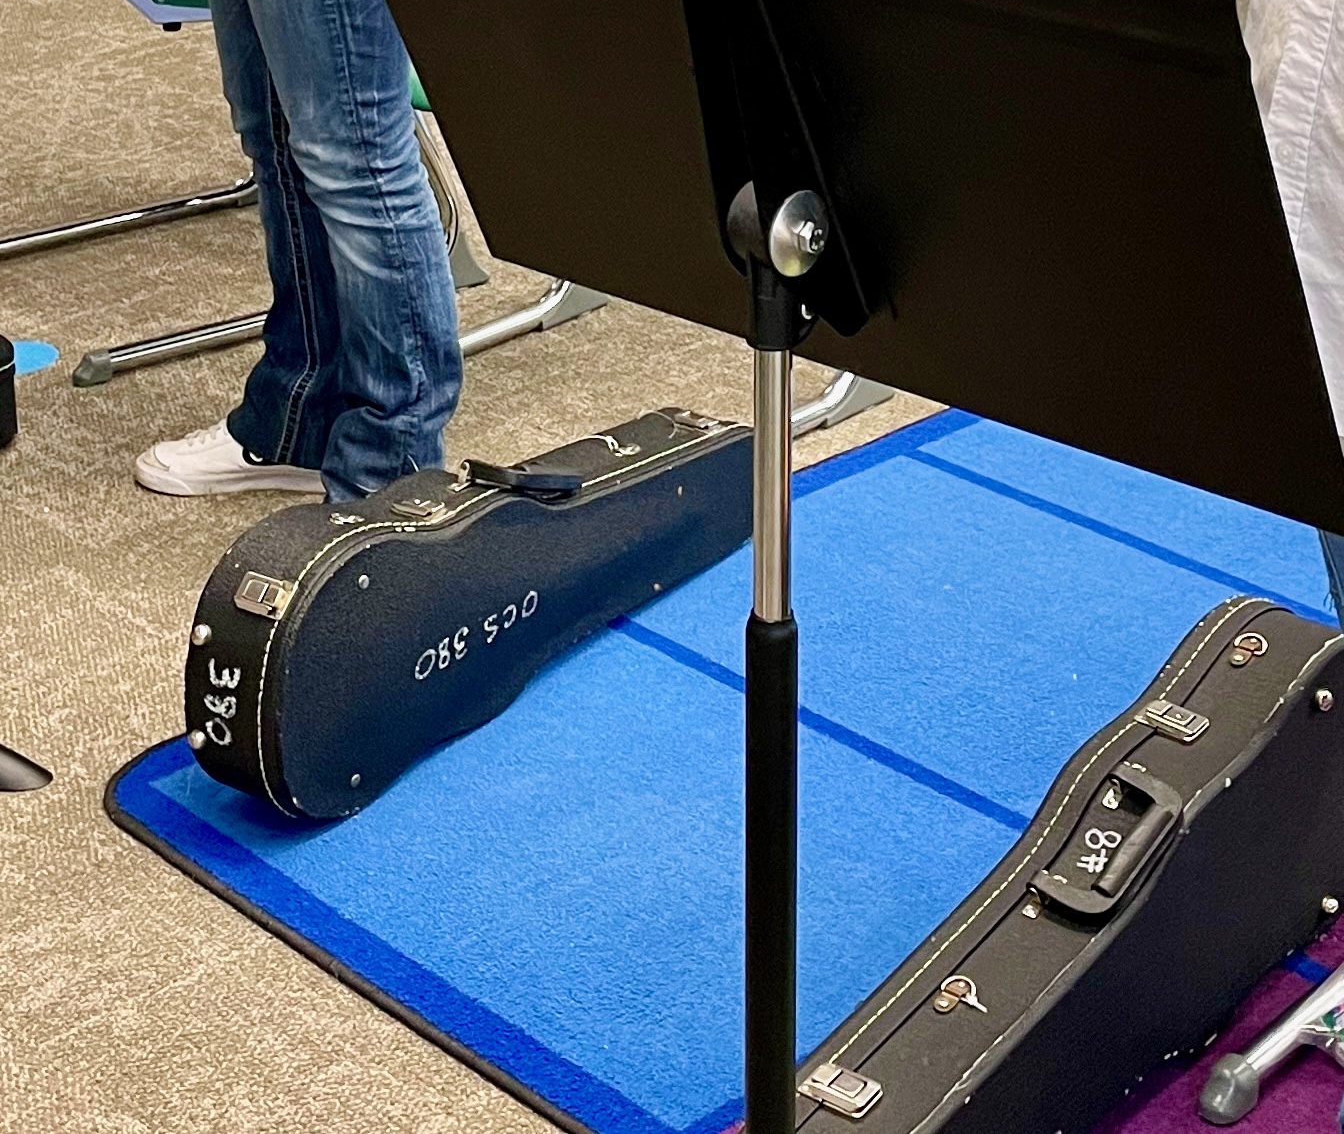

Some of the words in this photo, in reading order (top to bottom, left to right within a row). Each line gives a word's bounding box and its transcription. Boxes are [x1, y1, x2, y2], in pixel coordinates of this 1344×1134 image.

[483, 590, 538, 644] OCS
[414, 626, 470, 680] 380
[203, 657, 242, 747] 380
[1076, 828, 1123, 873] #8
